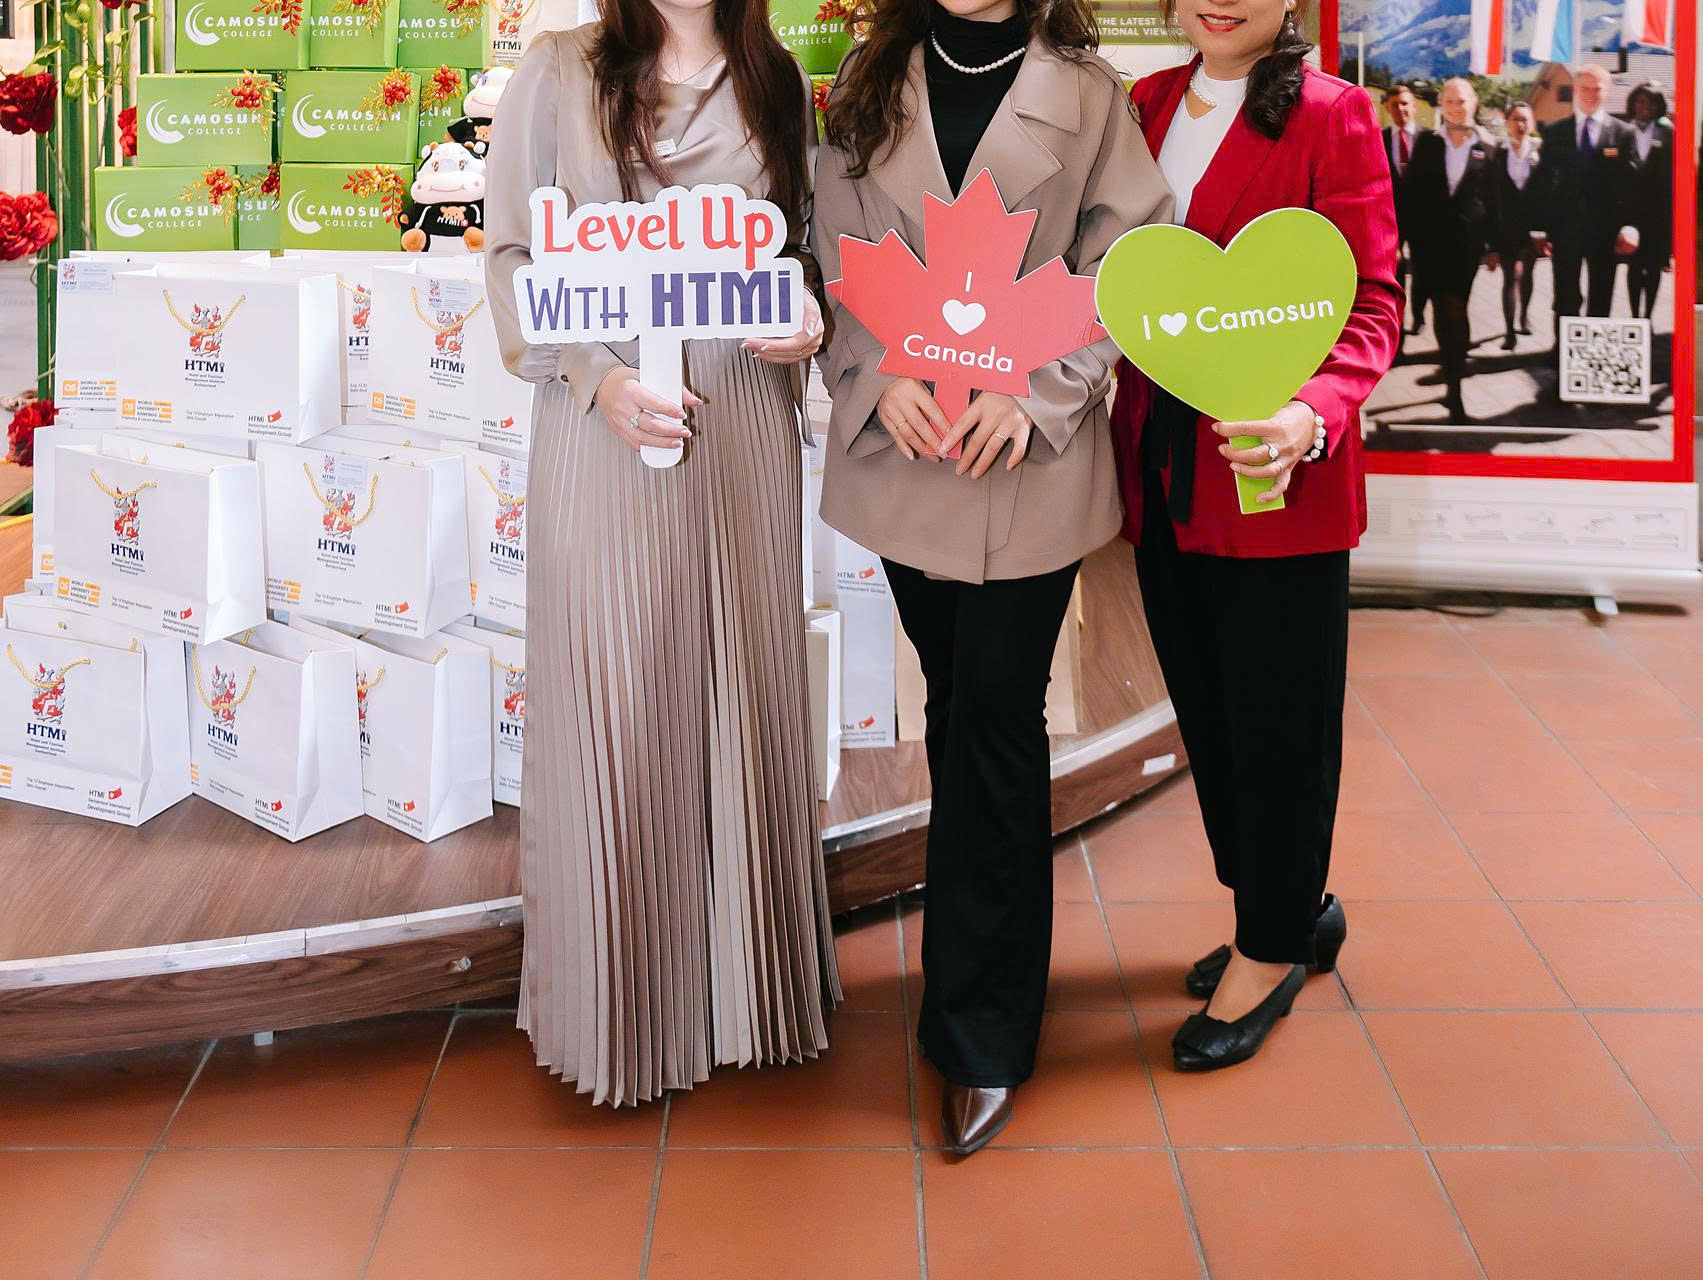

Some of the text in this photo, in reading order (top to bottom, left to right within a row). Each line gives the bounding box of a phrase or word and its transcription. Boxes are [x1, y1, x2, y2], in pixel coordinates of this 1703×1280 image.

[223, 30, 273, 38] COLLEGE
[312, 29, 360, 37] COLLEGE
[405, 31, 456, 39] COLLEGE
[778, 23, 846, 36] CAMOSU
[493, 40, 523, 51] HTMi
[792, 37, 833, 46] COLLEGE
[167, 113, 263, 125] CAMOSUN
[188, 127, 241, 136] COLLEGE
[330, 123, 380, 132] COLLEGE
[147, 220, 202, 229] COLLEGE
[325, 219, 374, 228] COLLEGE
[542, 197, 774, 270] Level Up
[965, 271, 973, 292] I
[652, 270, 791, 327] HTMi
[1143, 299, 1334, 340] I Camosun
[349, 336, 369, 346] HT
[903, 334, 1013, 372] Canada
[184, 360, 225, 373] HTMi
[430, 357, 466, 373] HTMi
[248, 415, 264, 423] HTMi
[483, 419, 497, 427] HTMi
[111, 543, 145, 561] HTMi
[317, 538, 357, 555] HTMi
[490, 542, 524, 561] HTMi
[164, 609, 177, 618] HTMi
[376, 604, 391, 612] HTMi
[26, 722, 67, 741] HTMi
[208, 723, 238, 746] HTMi
[500, 722, 524, 737] HT
[89, 789, 104, 798] HTMi
